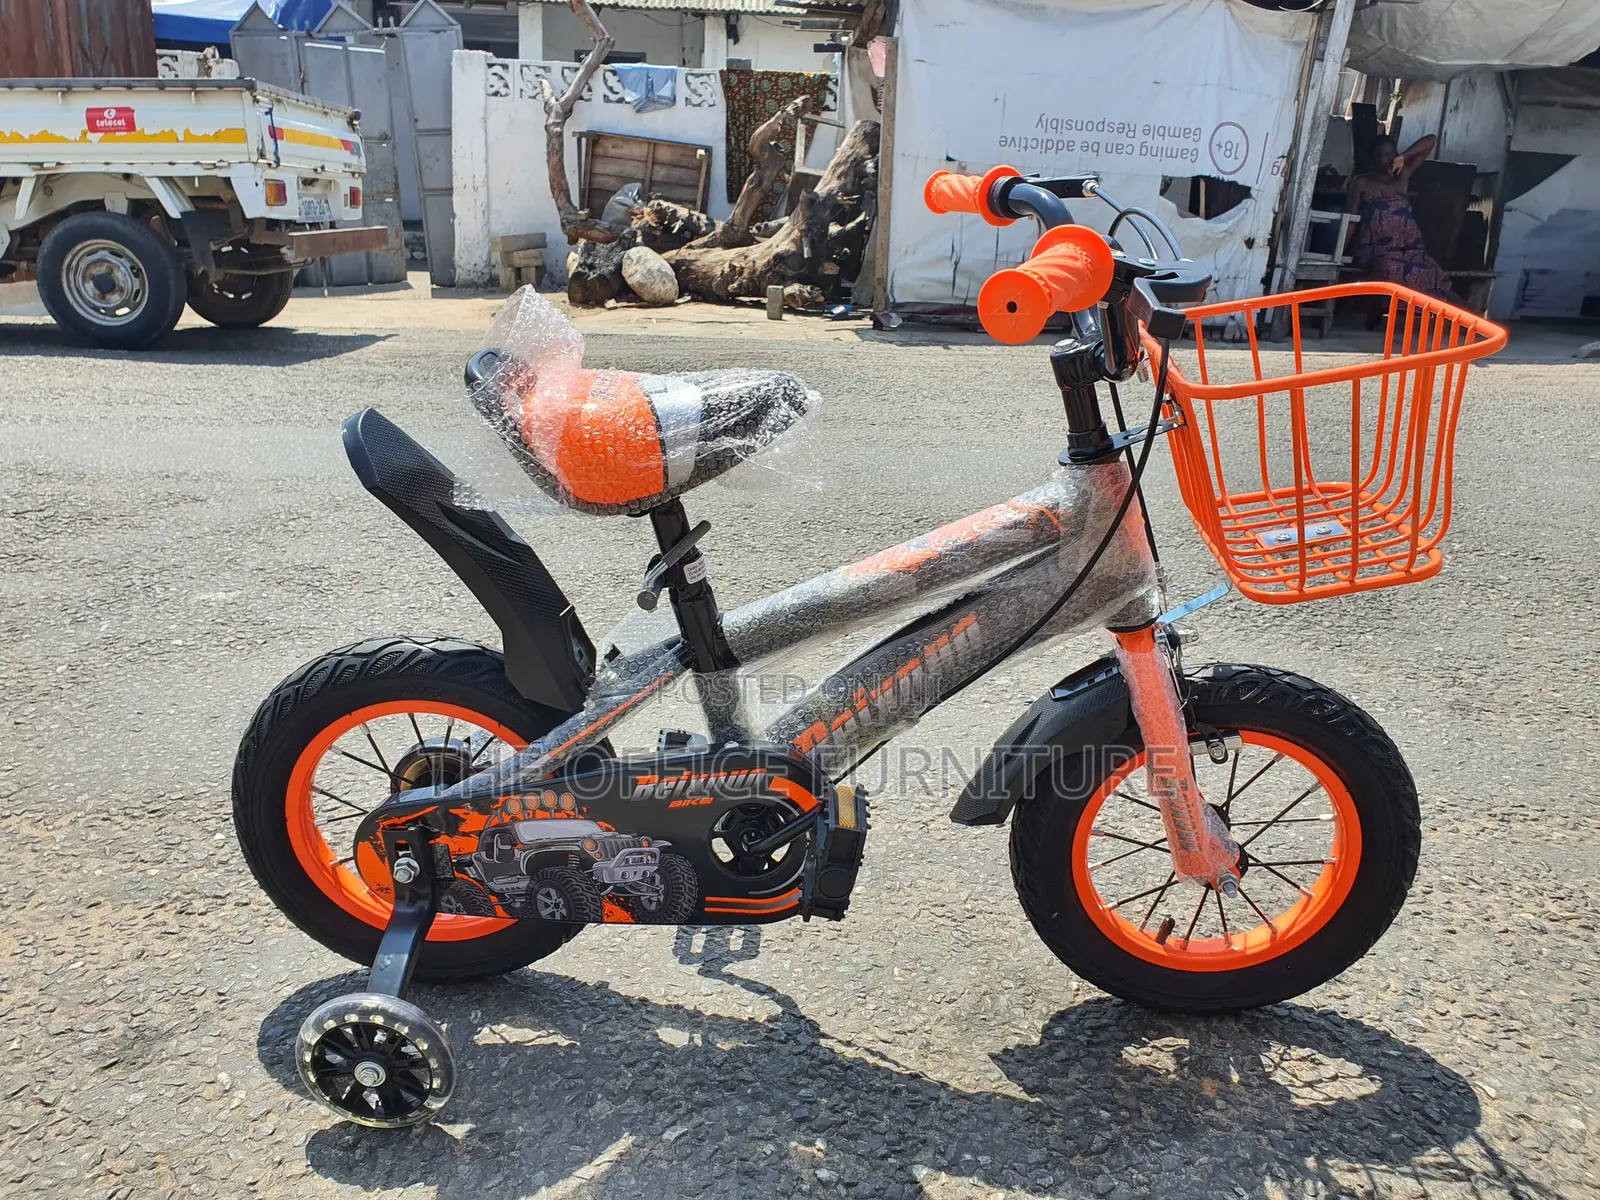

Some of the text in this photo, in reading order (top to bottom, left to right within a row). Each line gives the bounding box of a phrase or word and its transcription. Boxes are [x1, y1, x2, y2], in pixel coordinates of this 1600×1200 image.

[1035, 113, 1202, 142] Gamble Responsibly
[998, 135, 1199, 163] Gaming can be addictive
[1215, 140, 1240, 160] 18+
